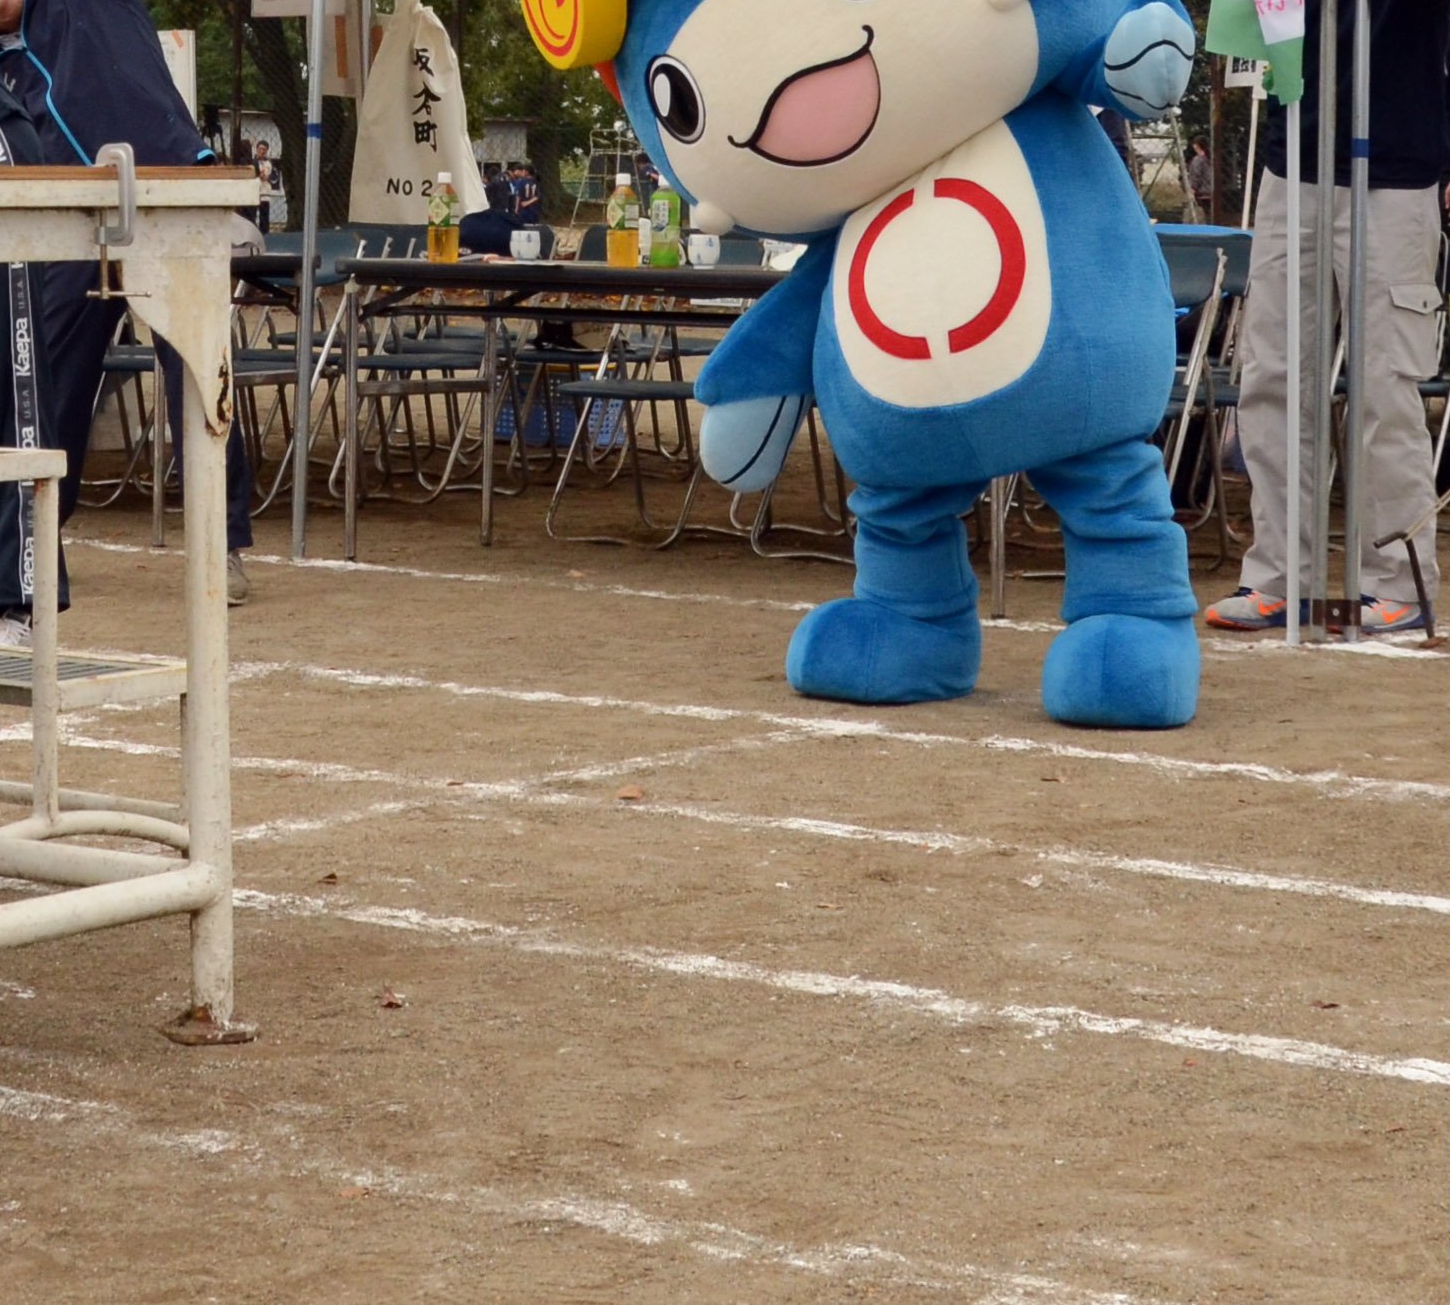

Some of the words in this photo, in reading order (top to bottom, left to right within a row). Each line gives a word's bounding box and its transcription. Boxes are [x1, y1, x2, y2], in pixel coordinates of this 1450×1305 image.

[386, 178, 413, 196] NO
[421, 180, 433, 196] 2
[525, 183, 537, 198] 11
[16, 317, 31, 377] Kaepa
